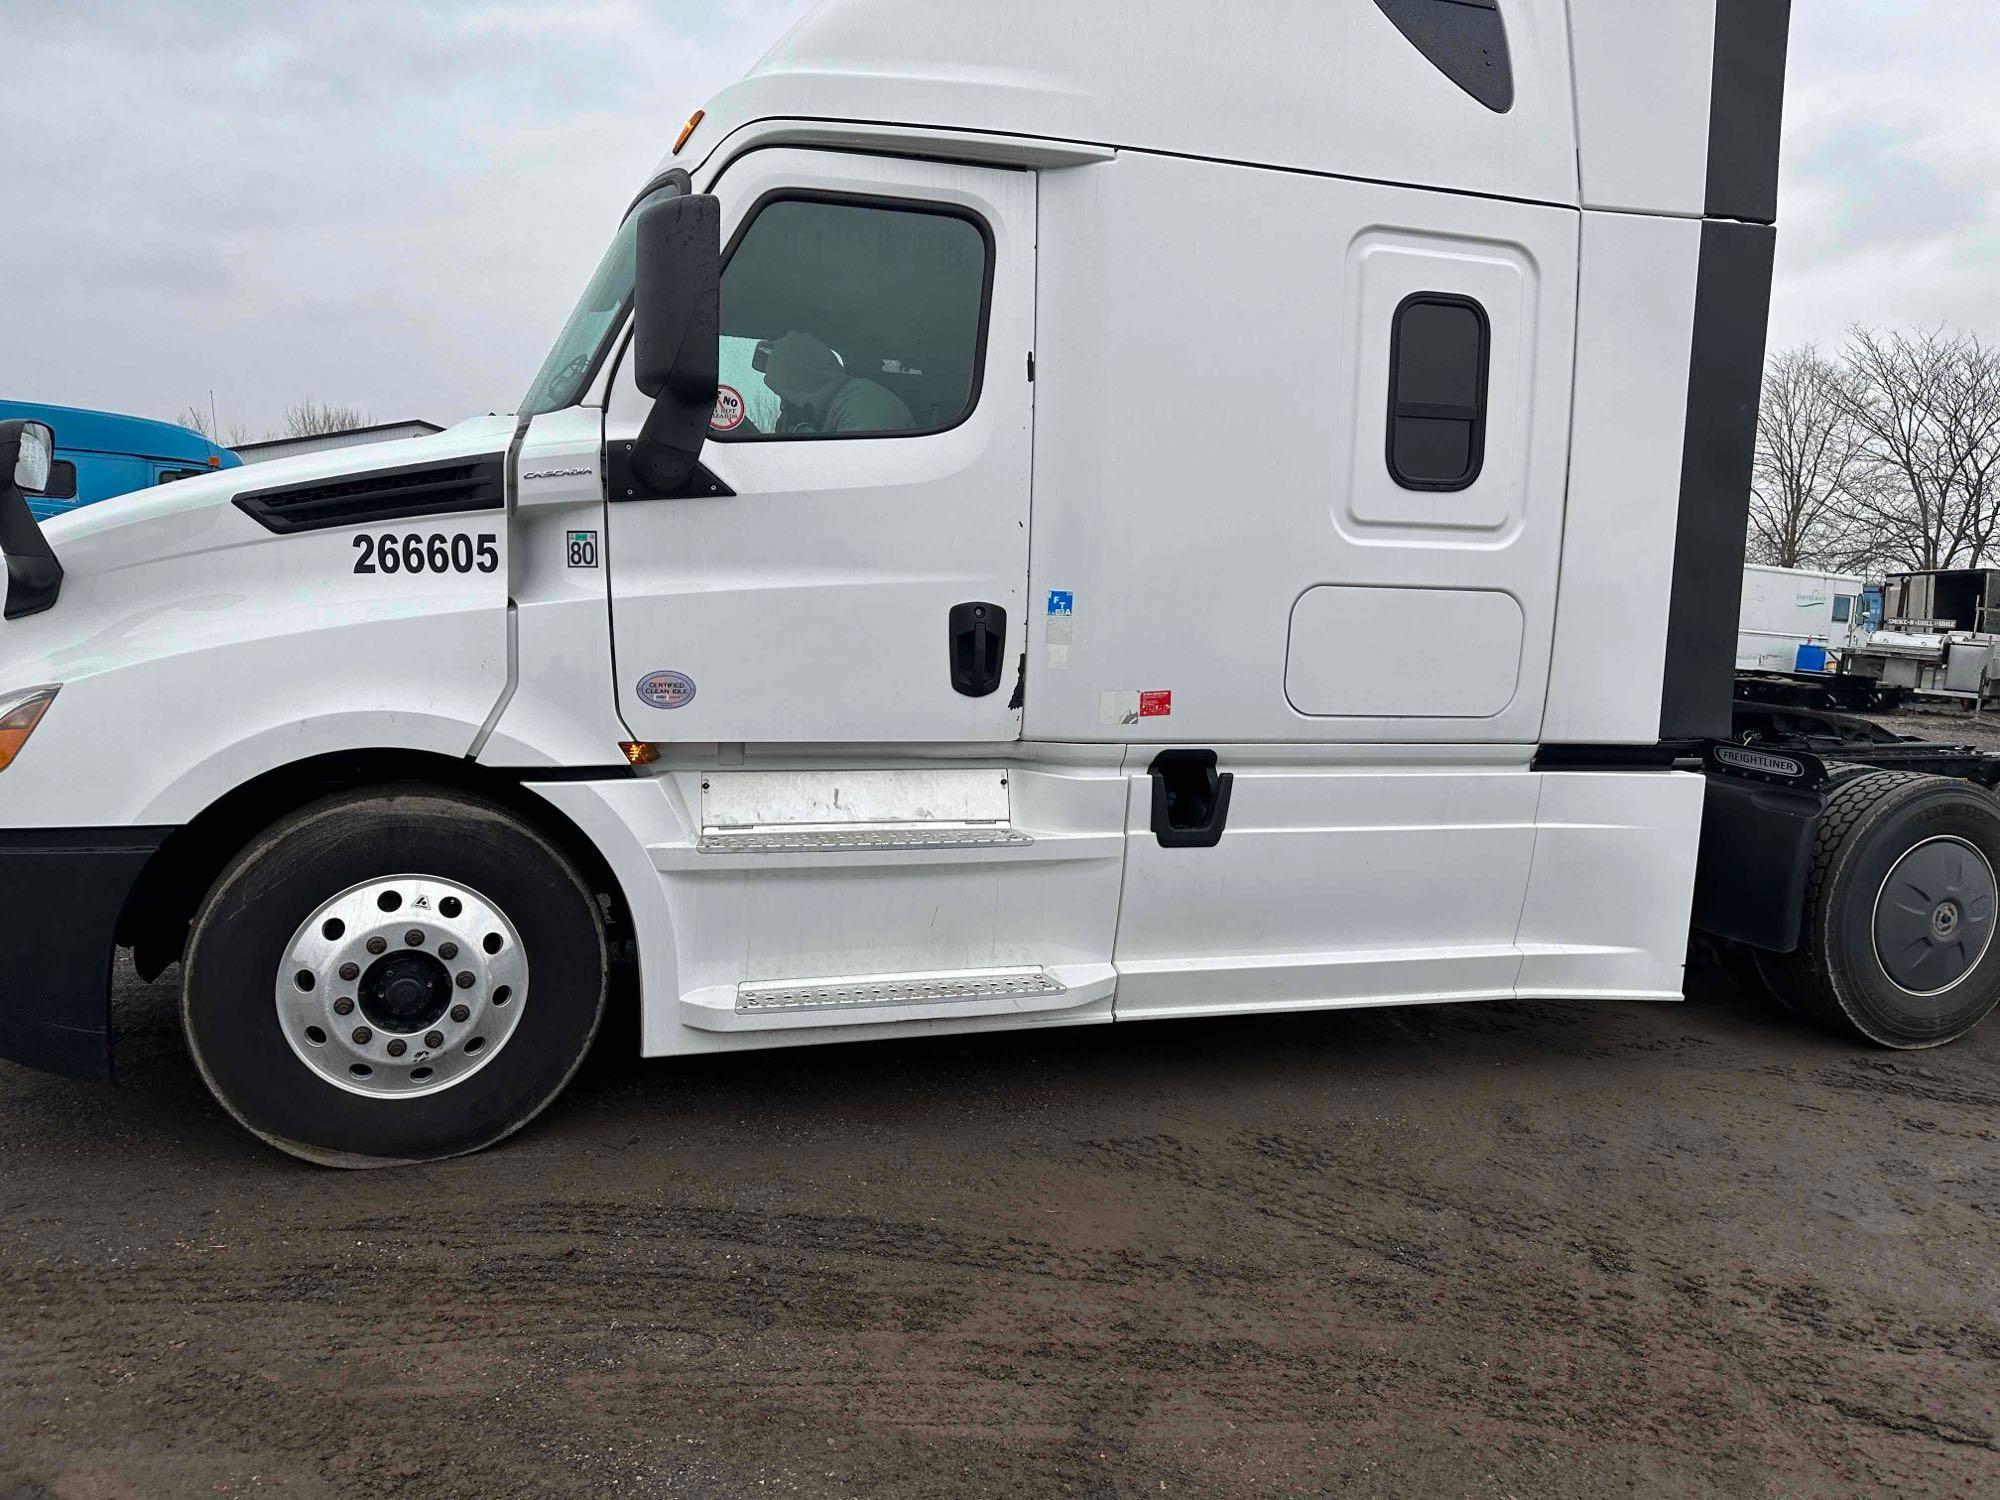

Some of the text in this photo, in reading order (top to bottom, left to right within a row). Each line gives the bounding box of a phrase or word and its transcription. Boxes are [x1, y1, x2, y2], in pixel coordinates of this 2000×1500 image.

[723, 395, 738, 407] NO
[523, 467, 592, 480] CASCADIA
[352, 533, 499, 574] 266605
[570, 541, 594, 565] 80
[1723, 750, 1794, 771] FREIGHTLINER
